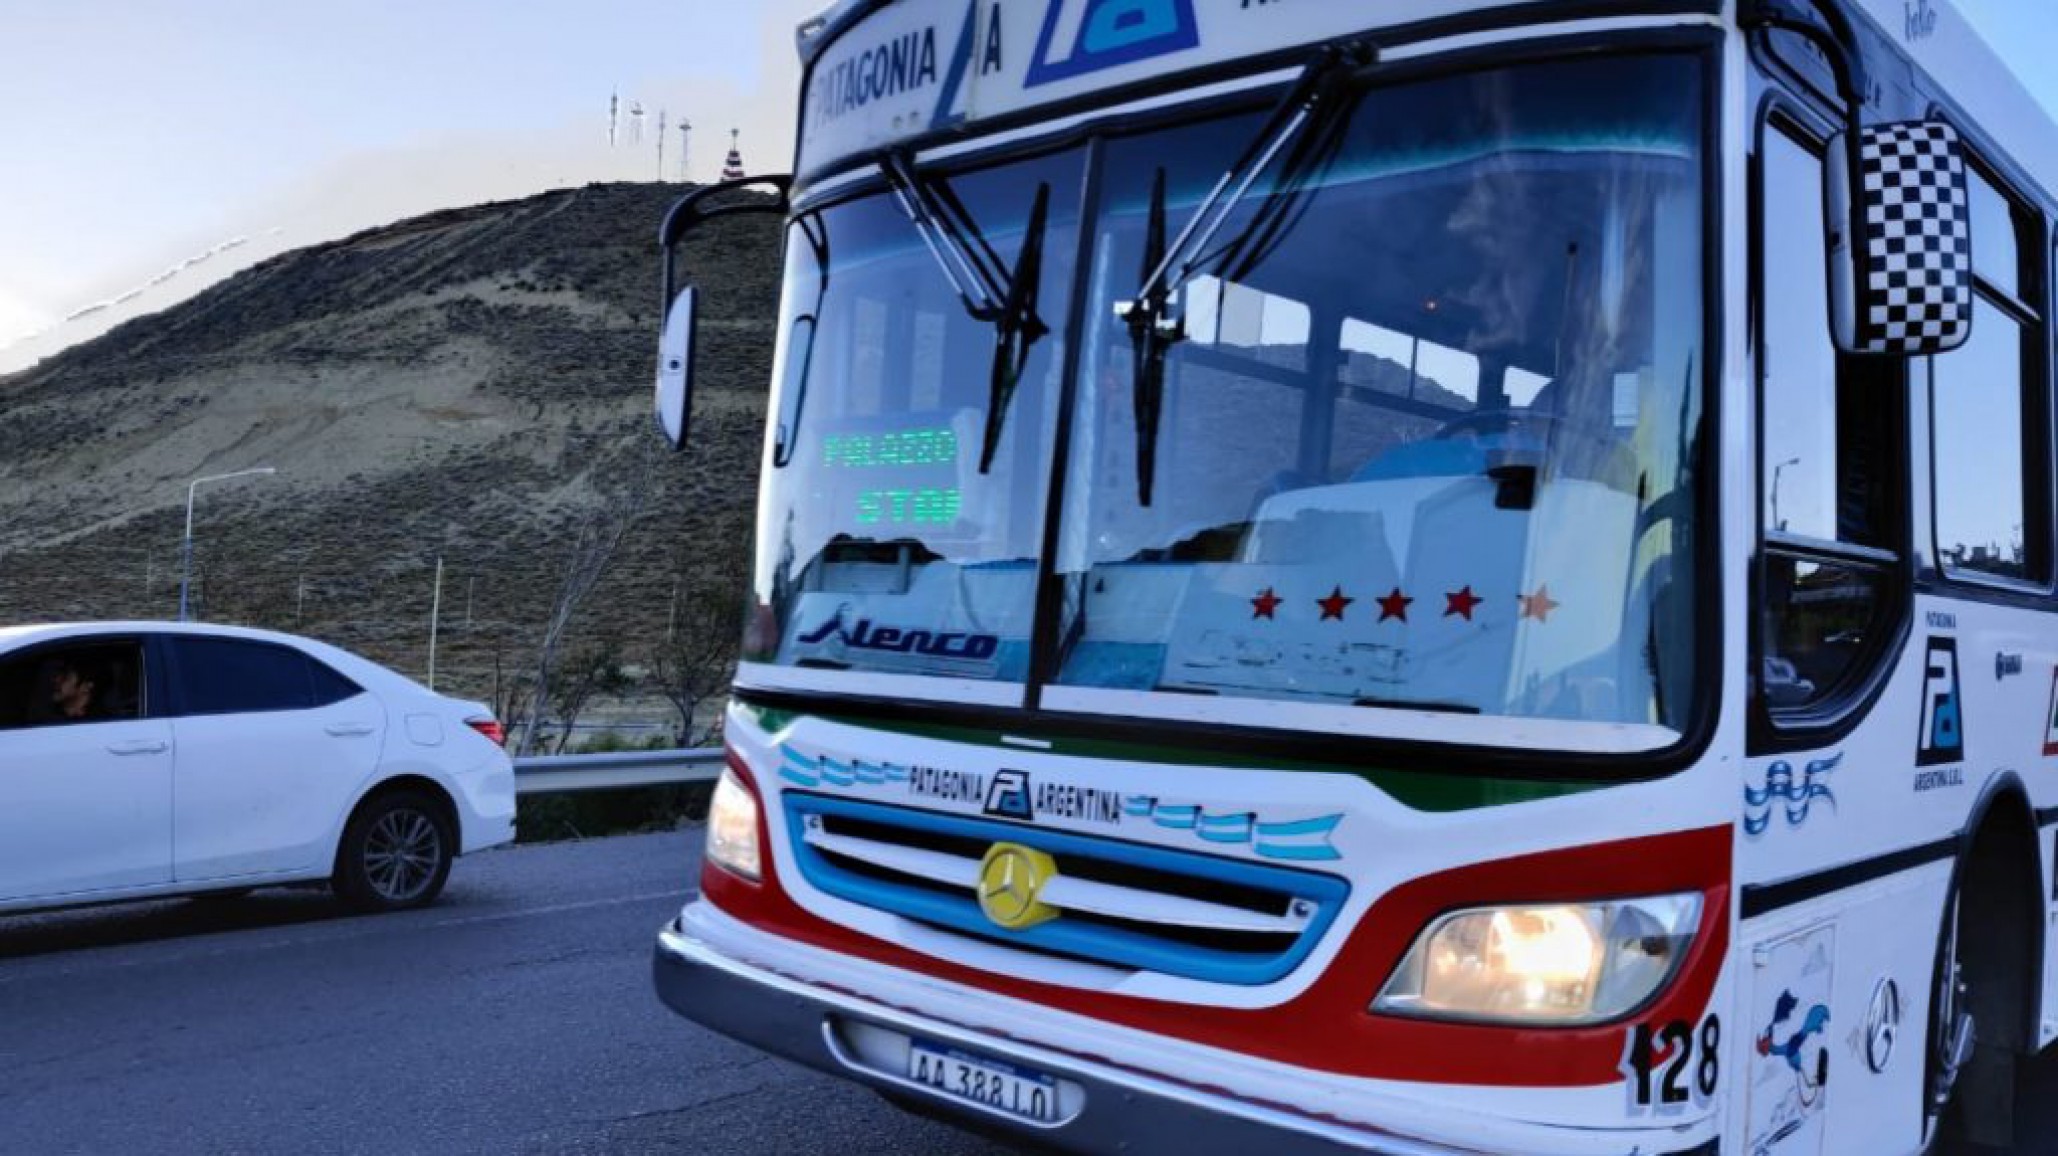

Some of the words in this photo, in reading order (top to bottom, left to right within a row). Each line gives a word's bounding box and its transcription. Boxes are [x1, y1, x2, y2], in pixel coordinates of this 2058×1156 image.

[798, 602, 998, 660] Alenco
[909, 766, 984, 803] PATAGONIA
[1037, 782, 1121, 824] ARGENTINA
[917, 1055, 945, 1087] AA
[957, 1064, 1003, 1106] 388
[1630, 1013, 1719, 1105] 128
